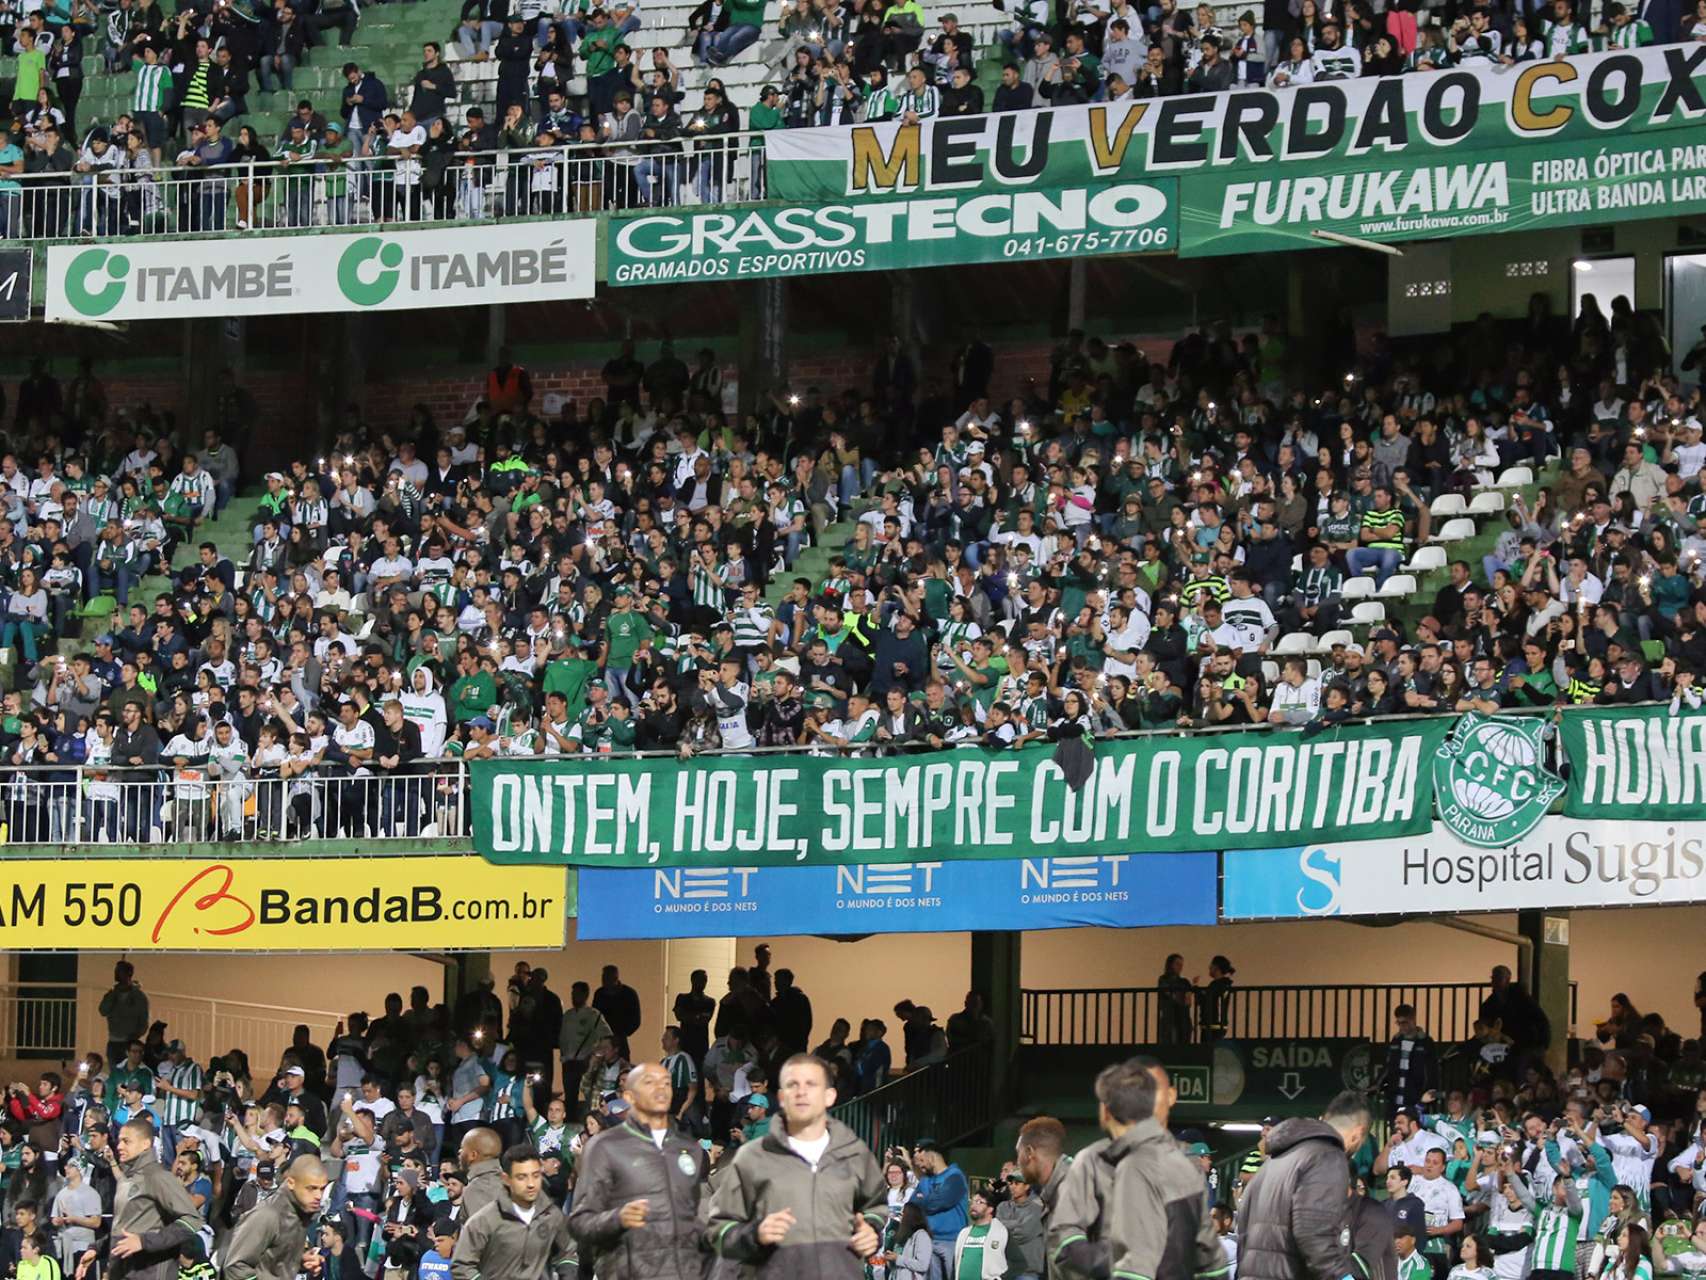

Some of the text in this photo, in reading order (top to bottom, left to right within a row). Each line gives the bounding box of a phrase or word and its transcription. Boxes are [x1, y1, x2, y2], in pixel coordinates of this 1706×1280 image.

[851, 45, 1706, 190] MEU VERDAO COX
[1532, 157, 1589, 185] FIBRA
[1594, 147, 1666, 178] ÓPTICA
[1220, 161, 1509, 228] FURUKAWA
[1532, 187, 1591, 215] ULTRA
[1597, 180, 1666, 209] BANDA
[616, 183, 1168, 258] GRASSTECNO
[1361, 208, 1509, 233] www.furukawa.com.br
[1004, 228, 1168, 257] 041-675-7706
[137, 254, 293, 301] ITAMBÉ
[411, 239, 568, 291] ITAMBÉ
[616, 249, 866, 282] GRAMADOS ESPORTIVOS
[492, 736, 1423, 863] ONTEM, HOJE, SEMPRE COM O CORITIBA
[837, 862, 942, 895] NET
[1021, 855, 1129, 889] NET
[1402, 827, 1704, 896] Hospital Sugis
[655, 866, 758, 899] NET
[1021, 891, 1128, 904] O MUNDO É DOS NETS
[0, 883, 141, 927] M 550
[260, 886, 552, 925] BandaB.com.br
[655, 901, 757, 913] O MUNDO É DOS NETS
[836, 897, 941, 909] O MUNDO É DOS NETS
[1252, 1043, 1333, 1069] SAÍDA
[1172, 1073, 1204, 1097] ÍDA
